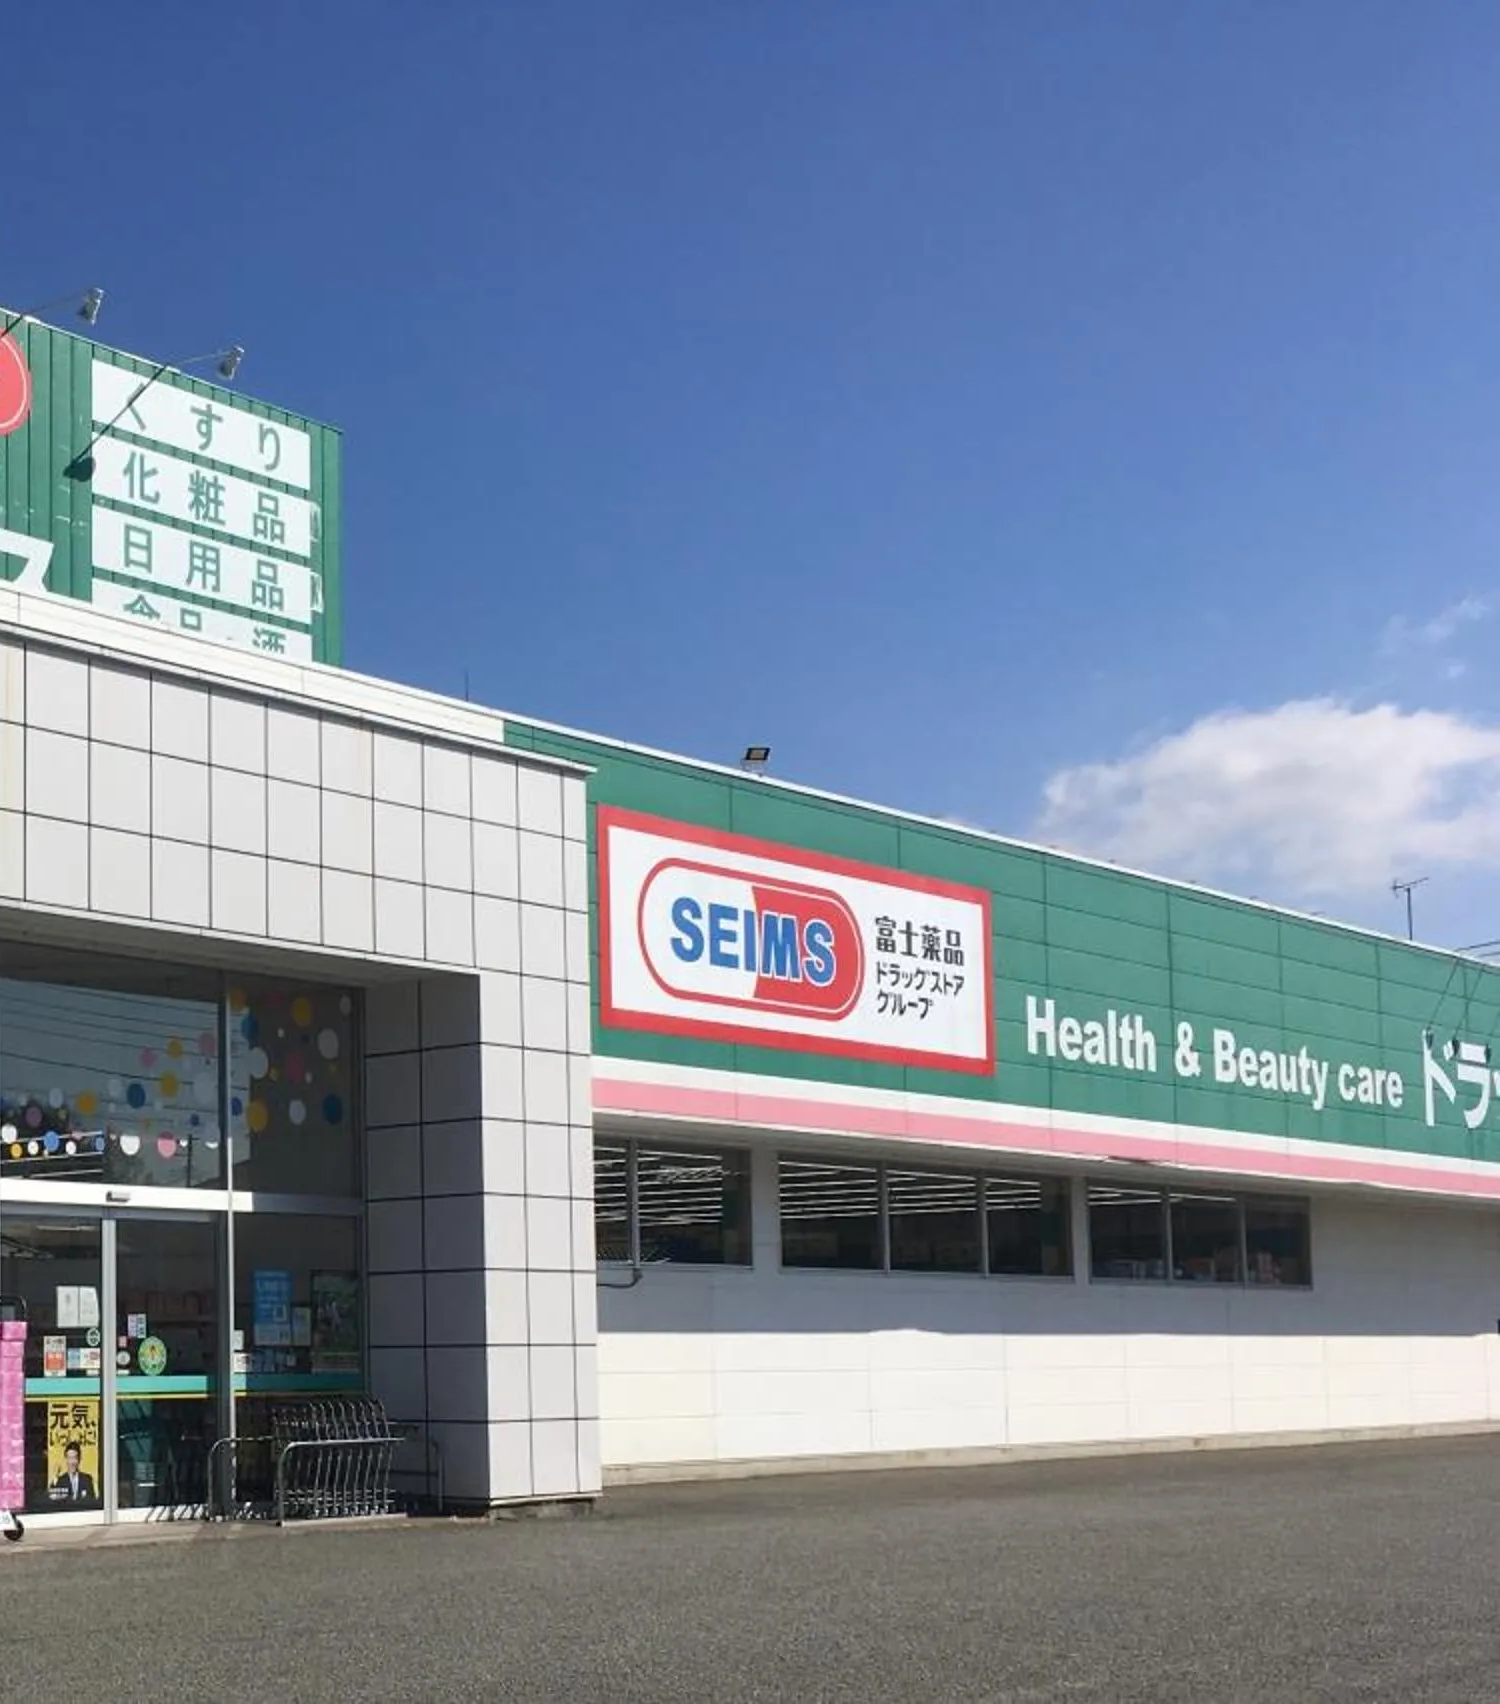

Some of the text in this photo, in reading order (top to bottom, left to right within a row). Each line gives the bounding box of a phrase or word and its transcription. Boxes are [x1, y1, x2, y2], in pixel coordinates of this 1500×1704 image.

[124, 393, 282, 471] くすり
[123, 451, 288, 545] 化粧品
[123, 523, 286, 612] 日用品
[670, 896, 835, 987] SEIMS
[875, 915, 965, 968] 富士薬品
[875, 960, 965, 997] ドラッグストア
[877, 989, 935, 1020] グループ
[1025, 994, 1404, 1111] Health & Beauty care
[1421, 1028, 1500, 1129] ドラ
